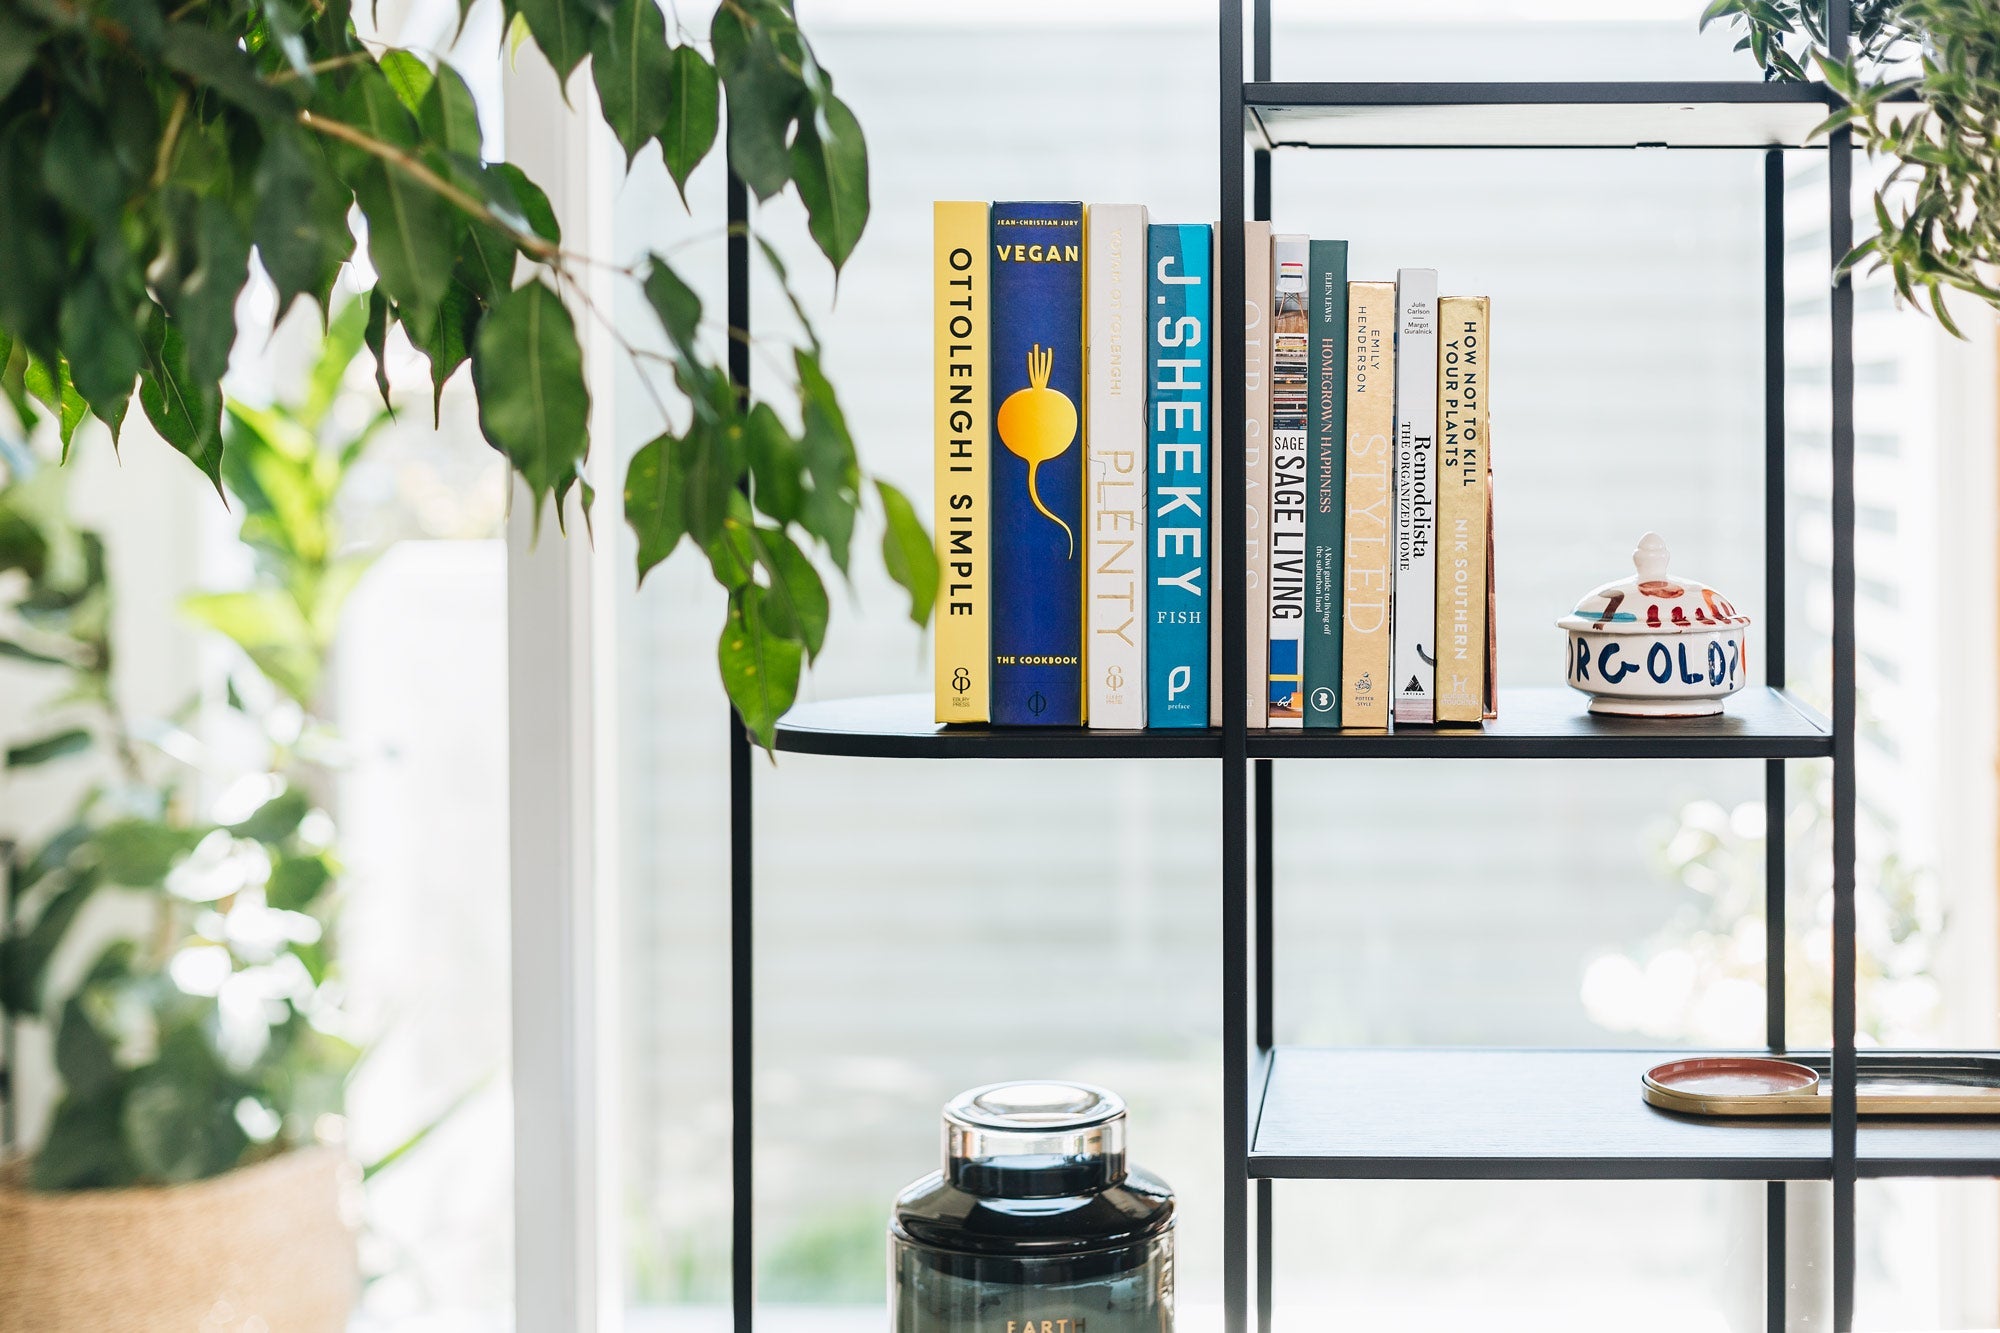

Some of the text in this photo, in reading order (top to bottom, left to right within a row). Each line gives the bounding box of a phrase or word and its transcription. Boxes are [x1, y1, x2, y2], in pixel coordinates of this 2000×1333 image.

[996, 244, 1079, 262] VEGAN
[1324, 297, 1333, 323] LEWIS
[1407, 321, 1429, 329] Margot
[1356, 306, 1367, 393] HENDERSON
[1370, 329, 1380, 370] EMILY
[949, 247, 973, 616] OTTOLENGHI SIMPLE
[1319, 338, 1334, 514] HOMEGROWN HAPPINESS
[1445, 340, 1459, 467] YOUR PLANTS
[1463, 321, 1477, 487] HOW NOT TO KILL
[1274, 436, 1305, 451] SAGE
[1273, 455, 1306, 524] SAGE
[1399, 421, 1411, 571] THE ORGANIZED HOME
[1413, 435, 1432, 559] Remodelista
[1096, 450, 1135, 648] PLENTY
[1348, 432, 1388, 634] STYLED
[1271, 532, 1304, 619] LIVING
[1315, 545, 1324, 613] the suburban land
[1322, 570, 1332, 592] guide
[1324, 593, 1331, 601] to
[1454, 519, 1468, 661] NIK SOUTHERN
[1156, 611, 1202, 624] FISH
[1322, 602, 1332, 624] living
[1323, 624, 1332, 636] off
[996, 656, 1078, 665] THE COOKBOOK
[1167, 702, 1191, 711] preface
